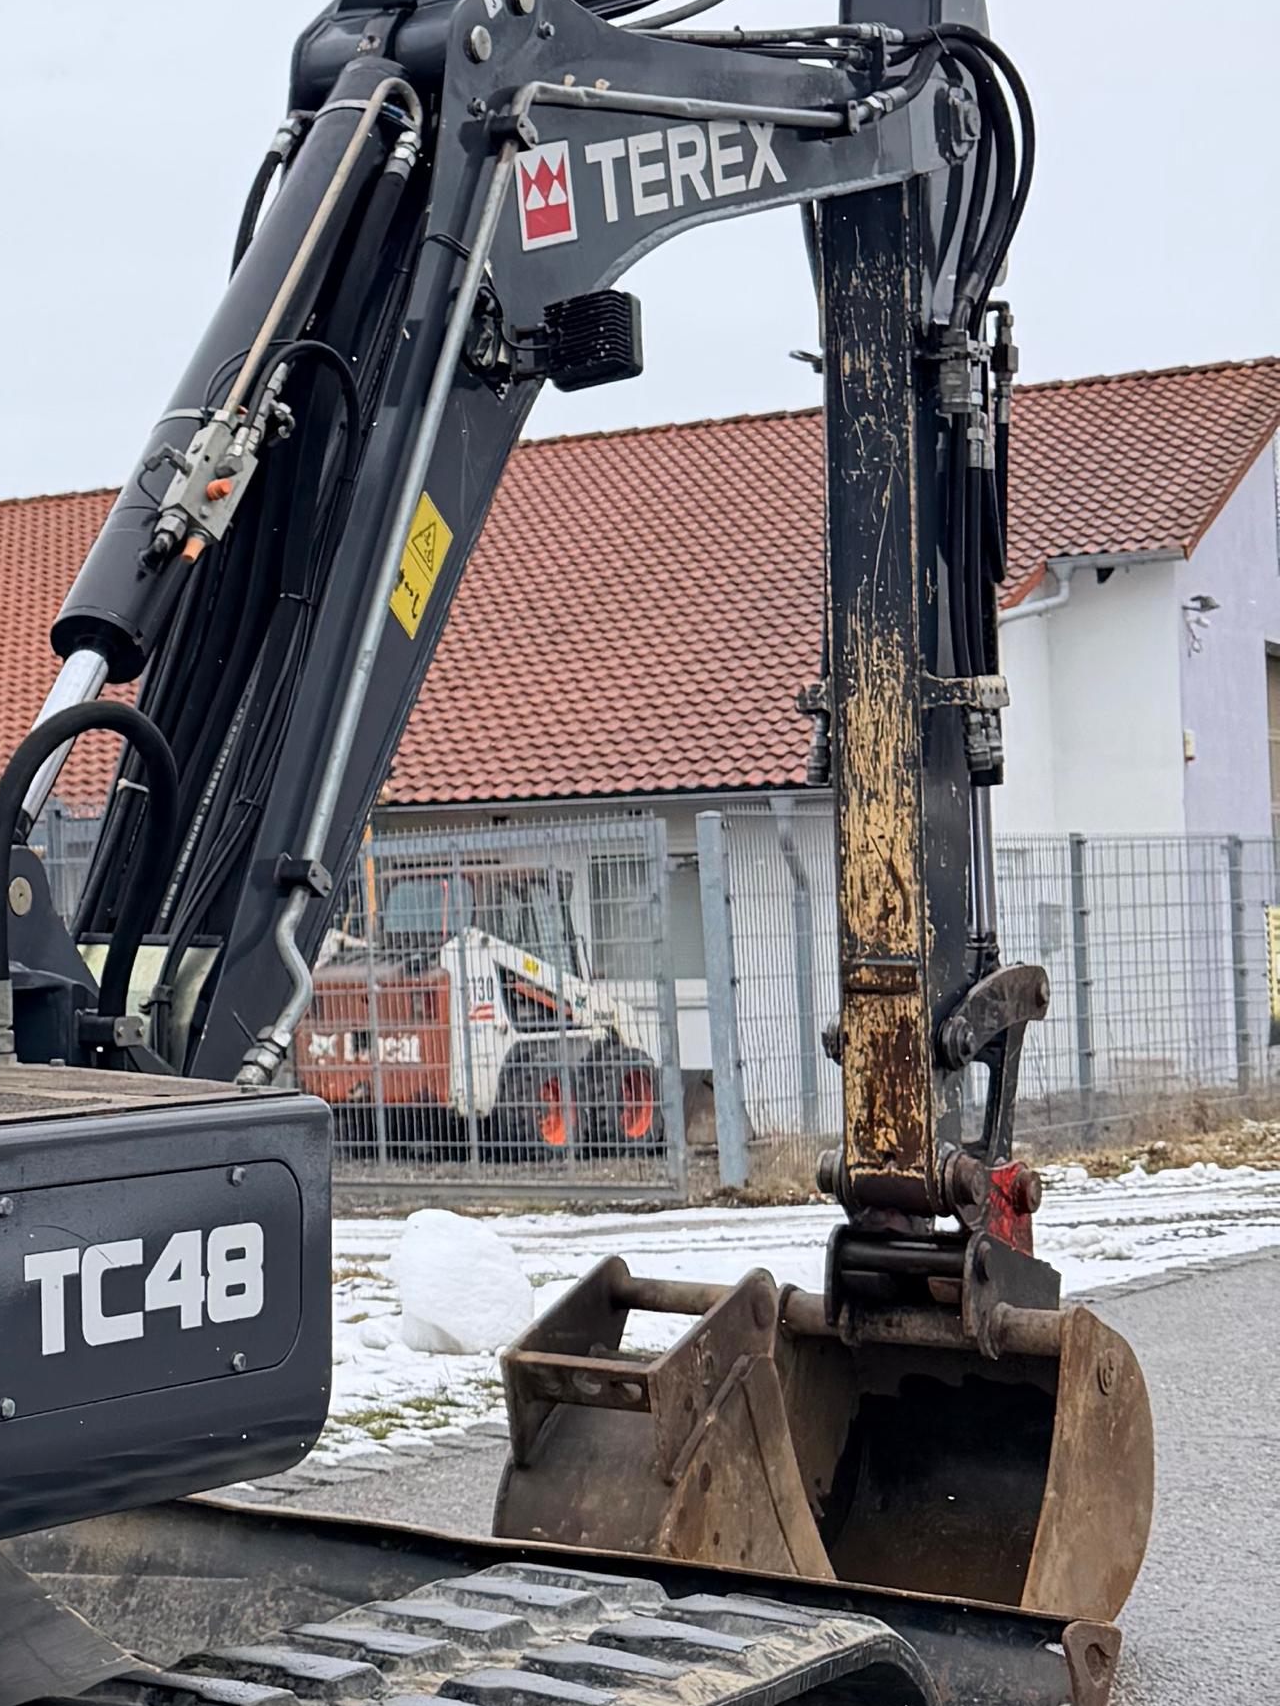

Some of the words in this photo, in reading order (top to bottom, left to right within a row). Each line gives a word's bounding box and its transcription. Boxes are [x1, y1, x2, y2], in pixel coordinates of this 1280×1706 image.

[585, 120, 787, 223] TEREX
[465, 976, 494, 1002] 130
[25, 1222, 265, 1355] TC48
